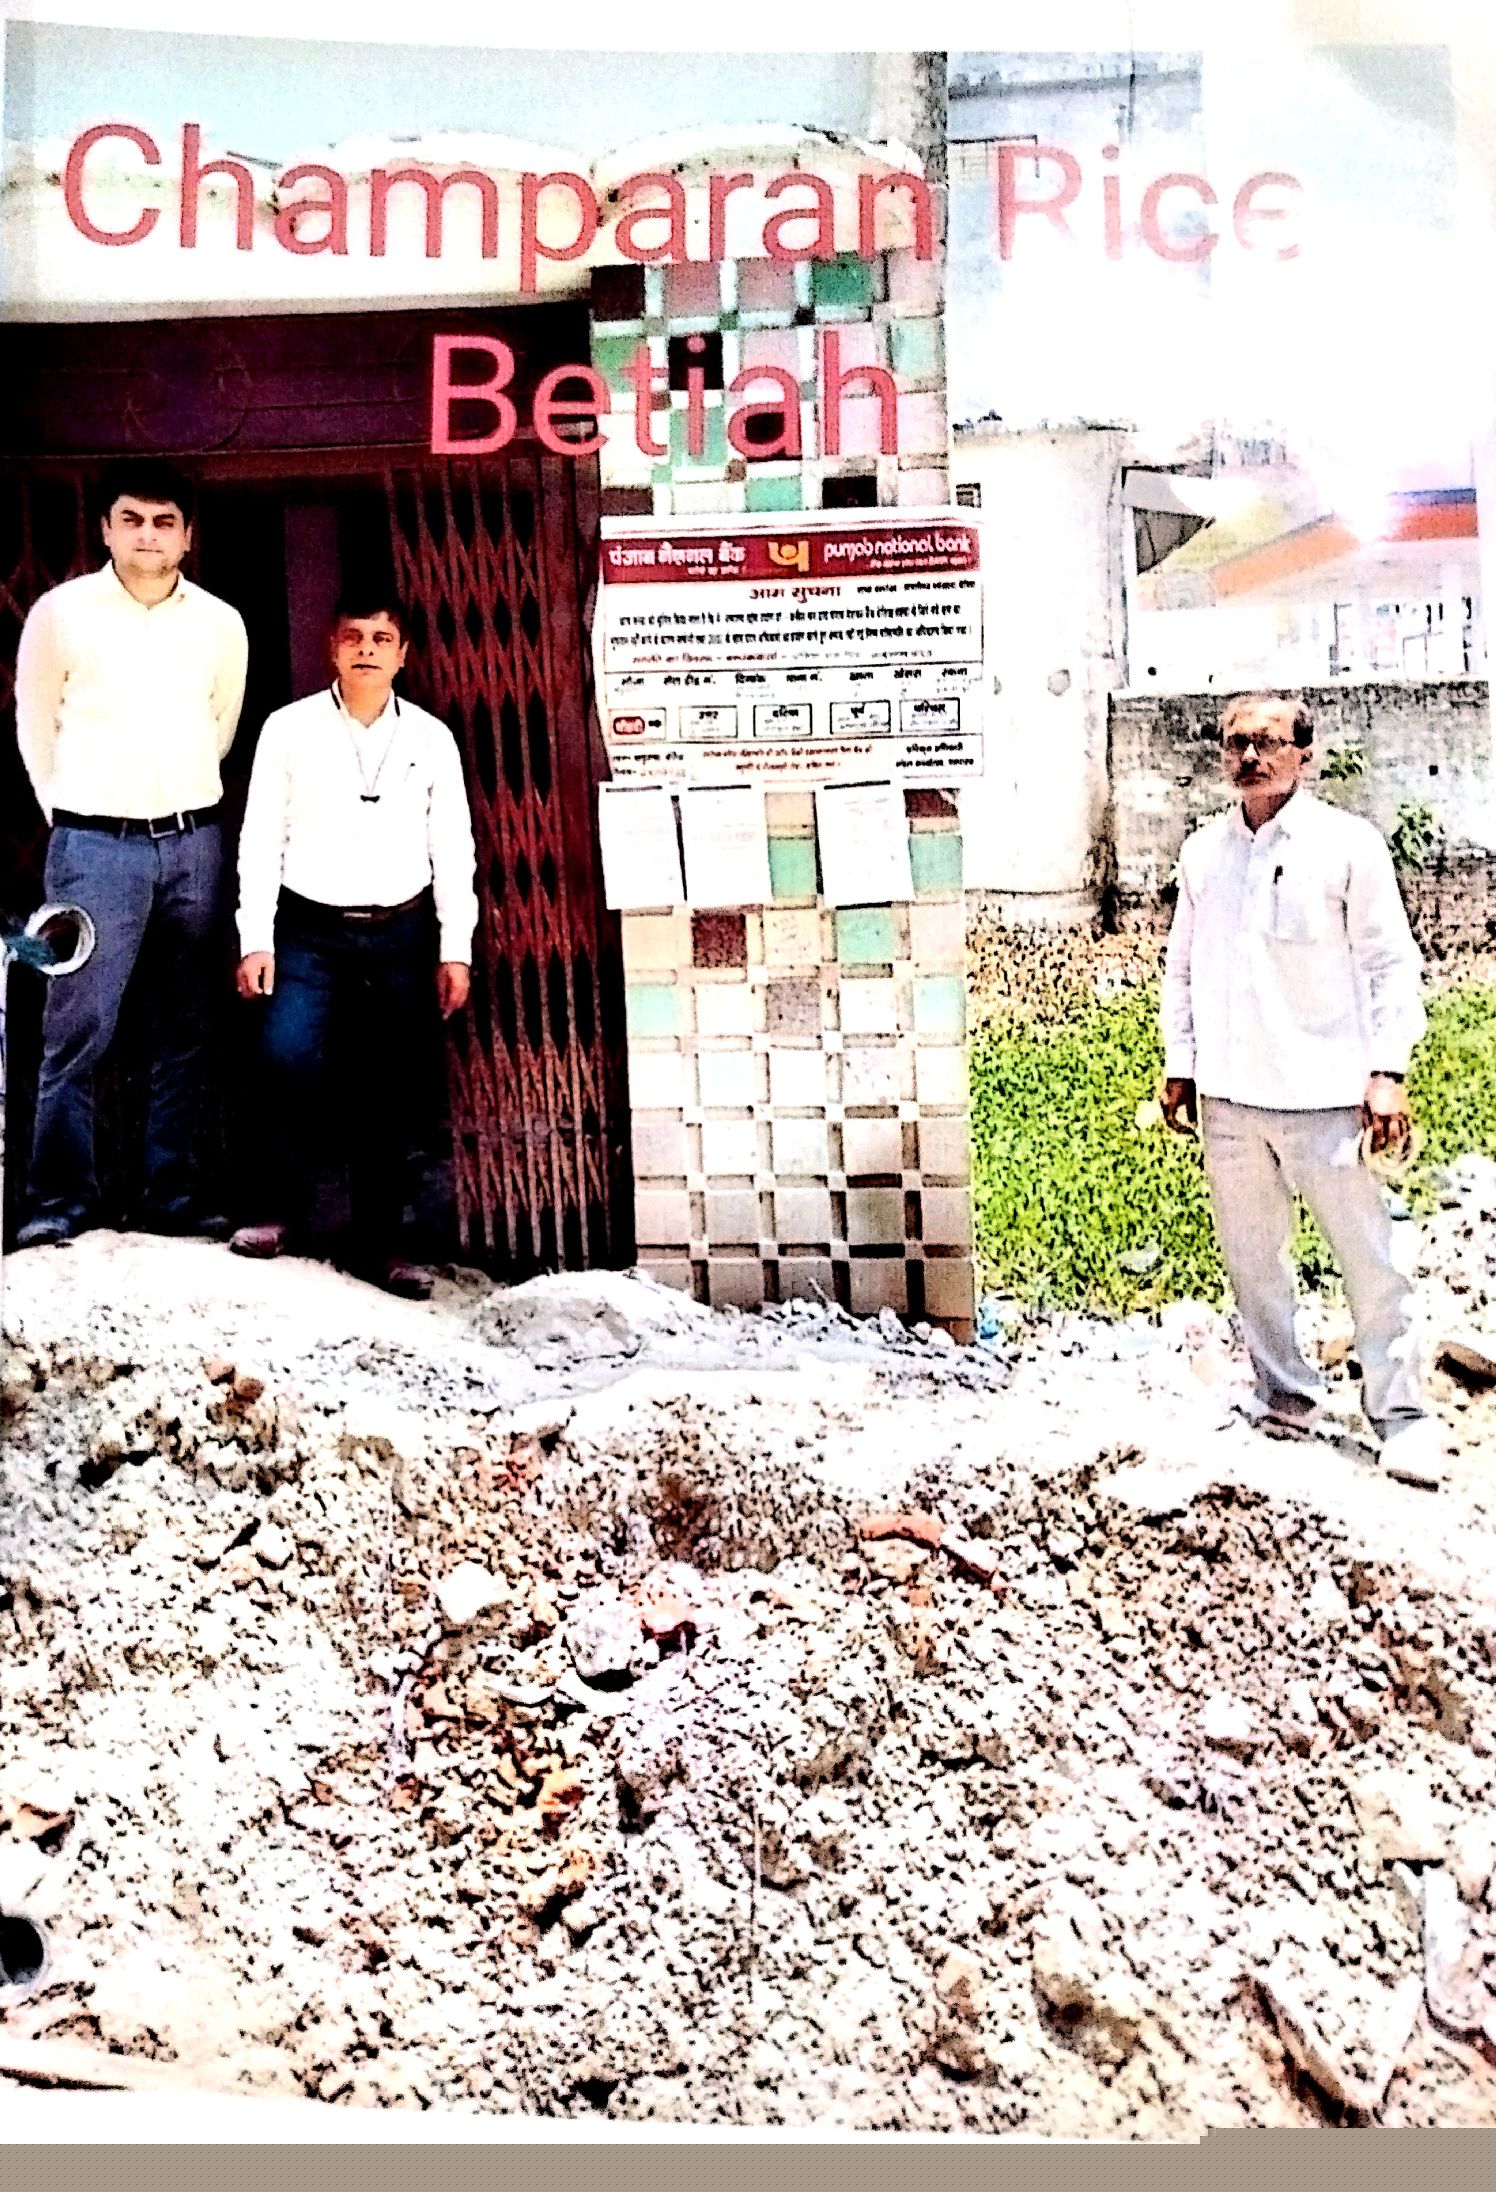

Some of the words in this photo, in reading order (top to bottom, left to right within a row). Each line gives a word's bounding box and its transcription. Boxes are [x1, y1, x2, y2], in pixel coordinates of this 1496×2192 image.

[718, 540, 746, 563] बैंक
[874, 534, 934, 555] national
[934, 531, 972, 553] bank
